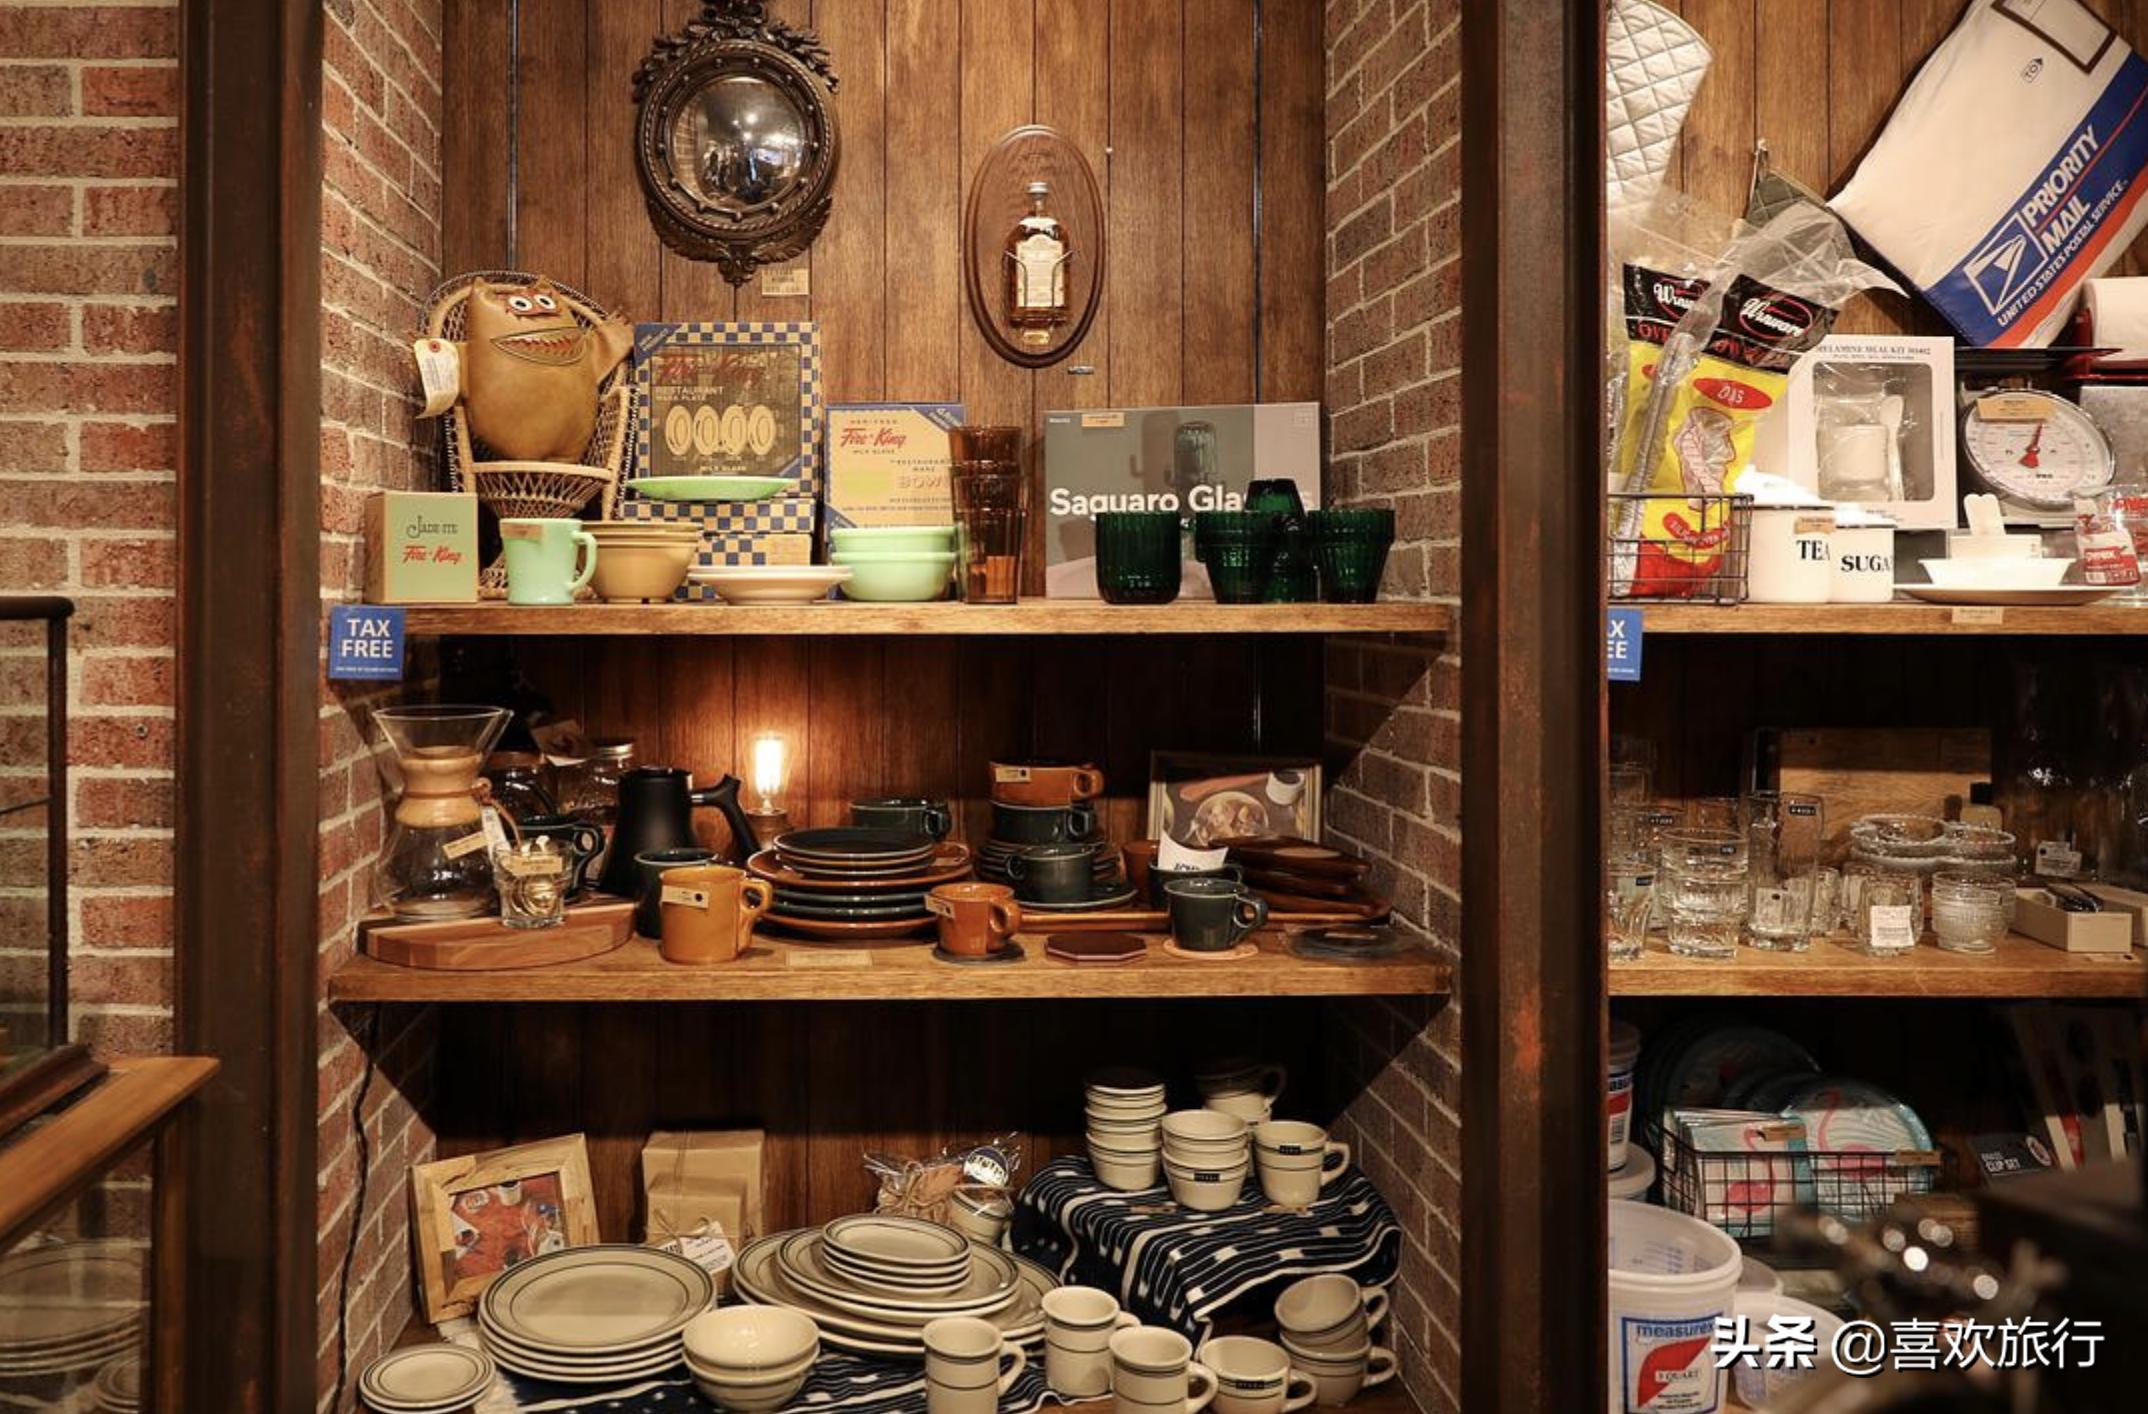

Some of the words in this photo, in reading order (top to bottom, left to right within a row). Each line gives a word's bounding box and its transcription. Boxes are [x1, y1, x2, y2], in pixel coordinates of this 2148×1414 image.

[2021, 124, 2100, 228] PRIORITY
[2040, 194, 2092, 254] MAIL
[1997, 286, 2038, 327] UNITED
[2035, 257, 2067, 293] STATES
[2064, 220, 2095, 260] POSTAL
[341, 639, 394, 659] FREE
[346, 618, 391, 638] TAX
